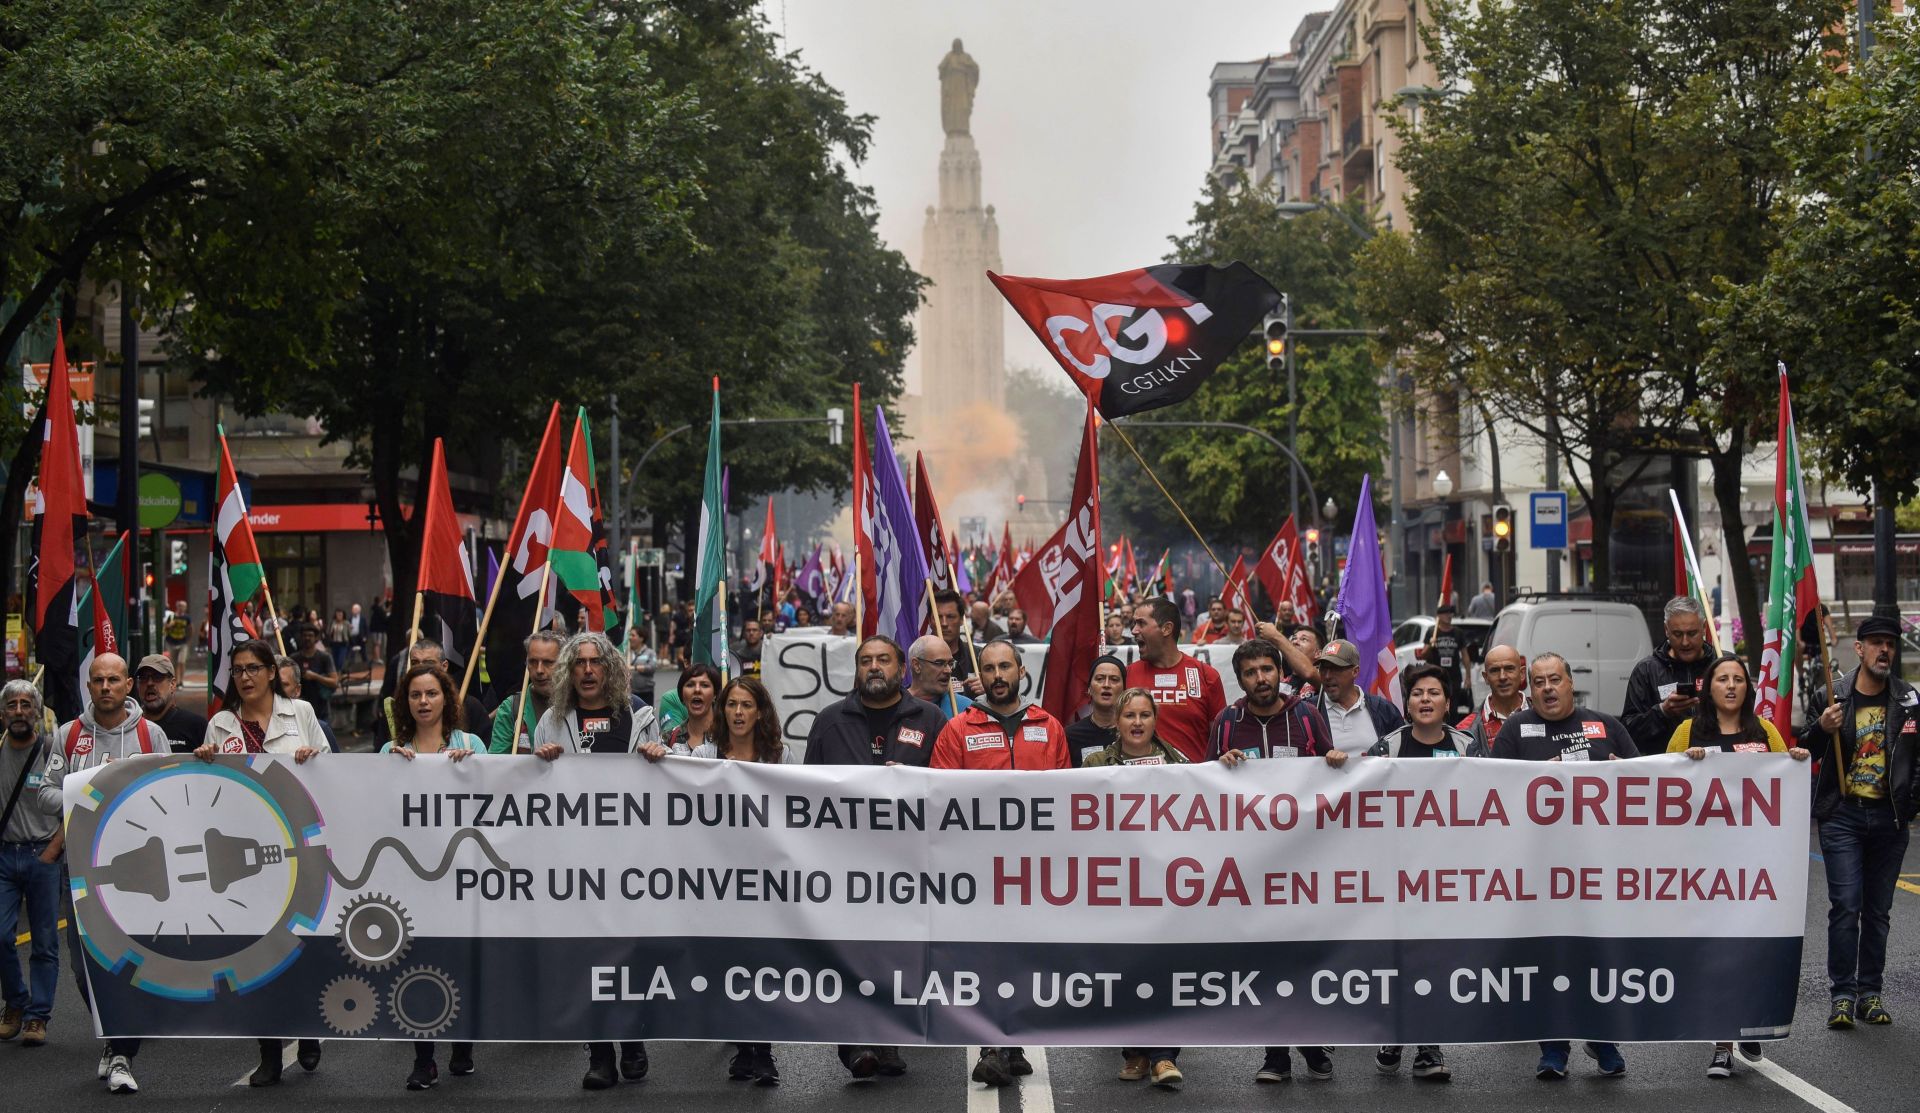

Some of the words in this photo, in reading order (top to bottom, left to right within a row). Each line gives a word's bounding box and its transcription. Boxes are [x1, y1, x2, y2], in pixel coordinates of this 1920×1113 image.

[1120, 348, 1203, 394] CGT-LKN
[586, 721, 609, 731] CNT
[77, 737, 93, 746] UGT
[902, 729, 922, 743] LAB
[978, 735, 1001, 744] CCOO
[224, 738, 240, 750] UGT
[402, 792, 651, 827] HITZARMEN
[667, 793, 769, 828] DUIN
[785, 795, 926, 832] BATEN
[939, 797, 1055, 831] ALDE
[1071, 793, 1299, 832] BIZKAIKO
[1316, 789, 1510, 828] METALA
[1526, 776, 1782, 827] GREBAN
[456, 868, 535, 901] POR
[548, 868, 606, 901] UN
[620, 868, 832, 904] CONVENIO
[846, 871, 977, 905] DIGNO
[993, 856, 1251, 907] HUELGA
[1264, 872, 1319, 905] EN
[1334, 870, 1384, 904] EL
[1398, 868, 1537, 903] METAL
[1551, 867, 1603, 900] DE
[1616, 867, 1778, 901] BIZKAIA
[591, 966, 676, 1002] ELA
[724, 966, 843, 1004] CCOO
[893, 970, 981, 1007] LAB
[1032, 972, 1122, 1008] UGT
[1172, 970, 1262, 1007] ESK
[1311, 969, 1399, 1005] CGT
[1449, 966, 1539, 1004] CNT
[1590, 967, 1675, 1004] USO
